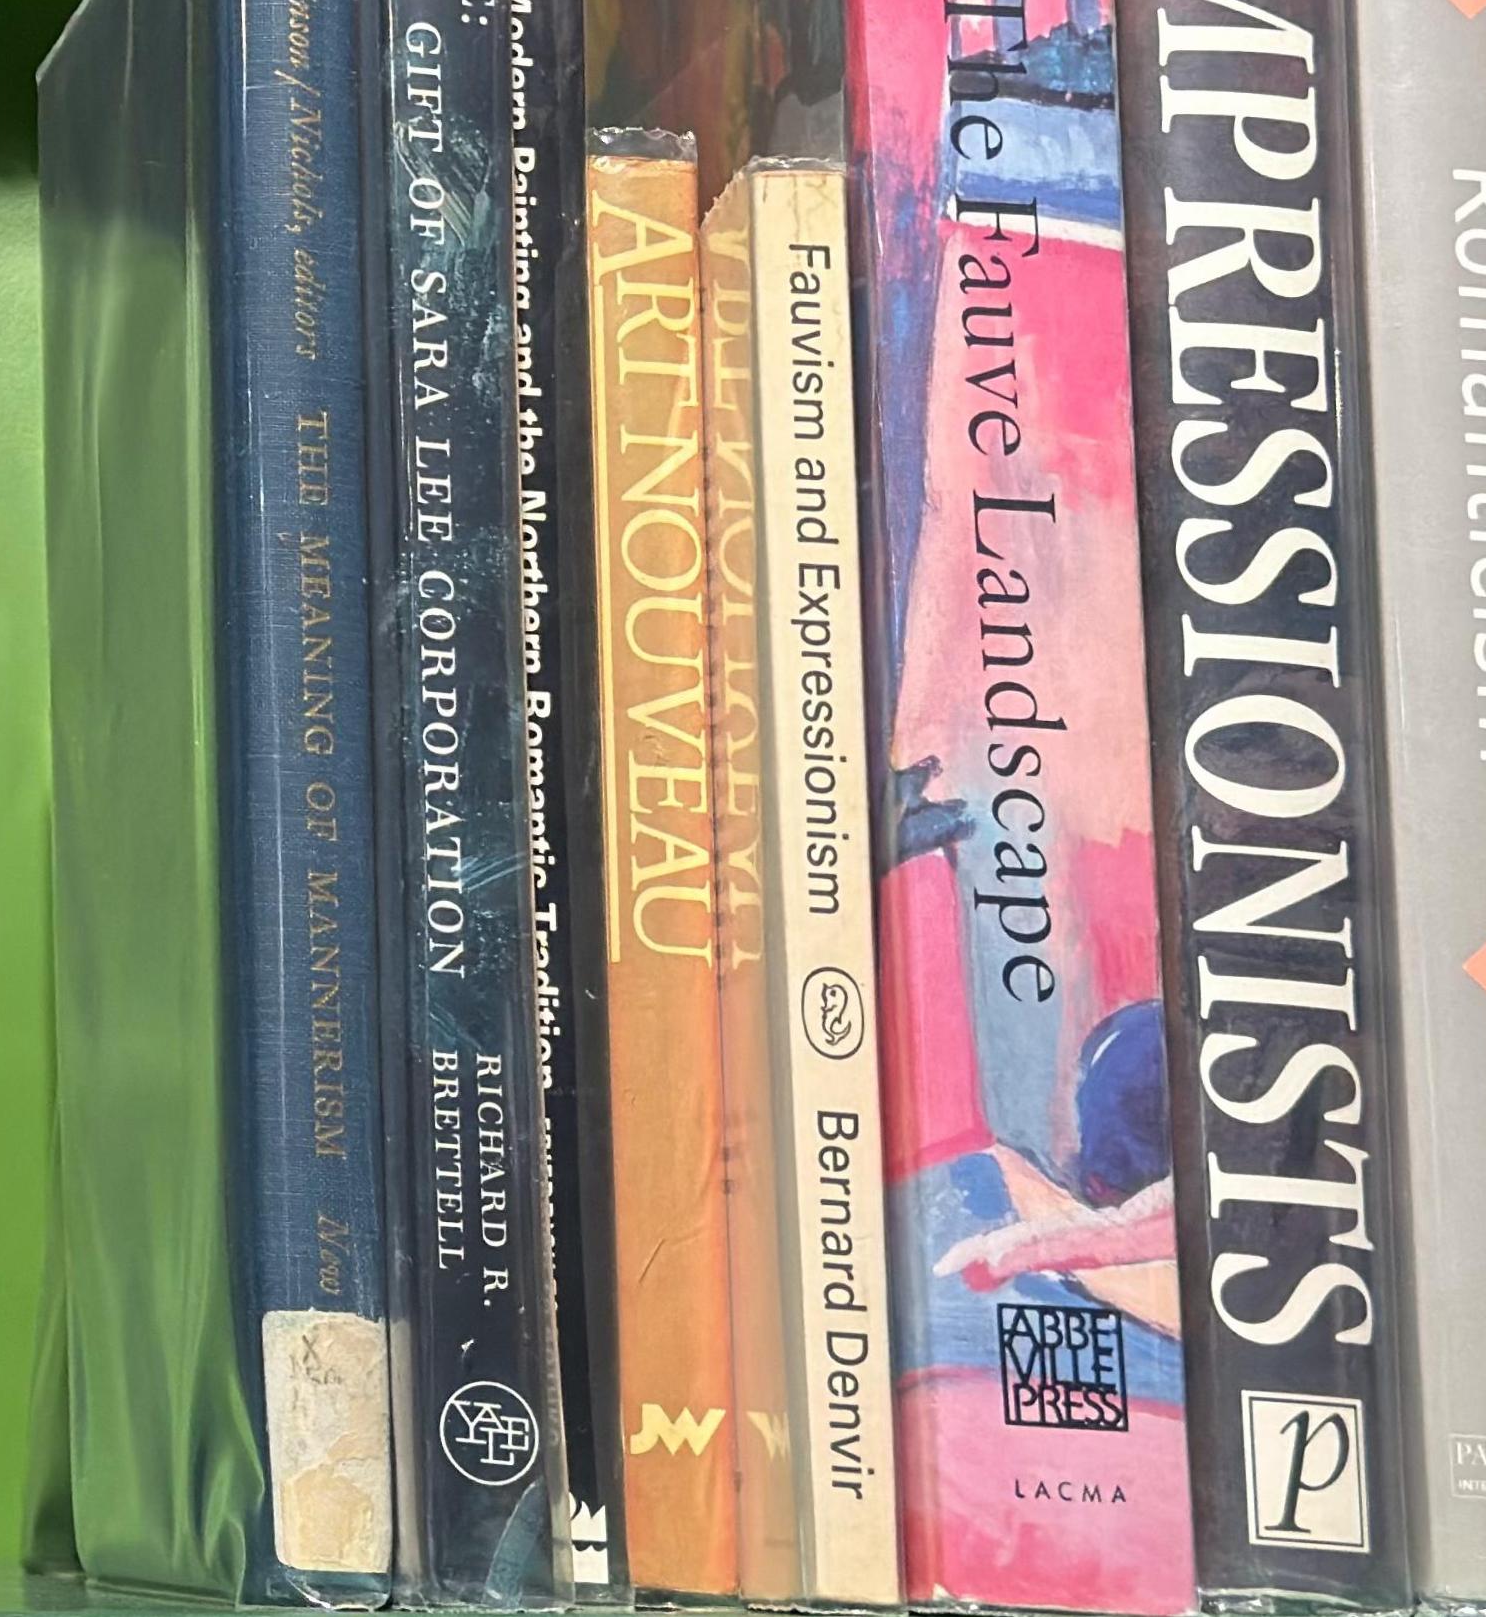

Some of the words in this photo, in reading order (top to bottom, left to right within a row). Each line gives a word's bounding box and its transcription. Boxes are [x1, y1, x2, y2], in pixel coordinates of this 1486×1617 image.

[404, 22, 443, 152] GIFT
[294, 247, 328, 362] editors
[407, 177, 446, 256] OF
[591, 189, 699, 408] ART
[410, 268, 451, 411] SARA
[788, 243, 834, 442] Fauvism
[948, 199, 1040, 457] Fauve
[296, 410, 329, 507] THE
[415, 435, 454, 544] LEE
[792, 454, 839, 547] and
[298, 532, 334, 758] MEANING
[618, 423, 714, 970] NOUVEAU
[790, 561, 850, 915] Expressionism
[303, 782, 337, 843] OF
[417, 569, 466, 979] CORPORATION
[968, 488, 1070, 1005] Landscape
[305, 871, 346, 1159] MANNERISM
[431, 1049, 469, 1270] BRETTELL
[475, 1052, 509, 1248] RICHARD
[815, 1109, 866, 1311] Bernard
[482, 1266, 509, 1308] R.
[825, 1331, 875, 1500] Denvir
[1014, 1478, 1127, 1503] LACMA
